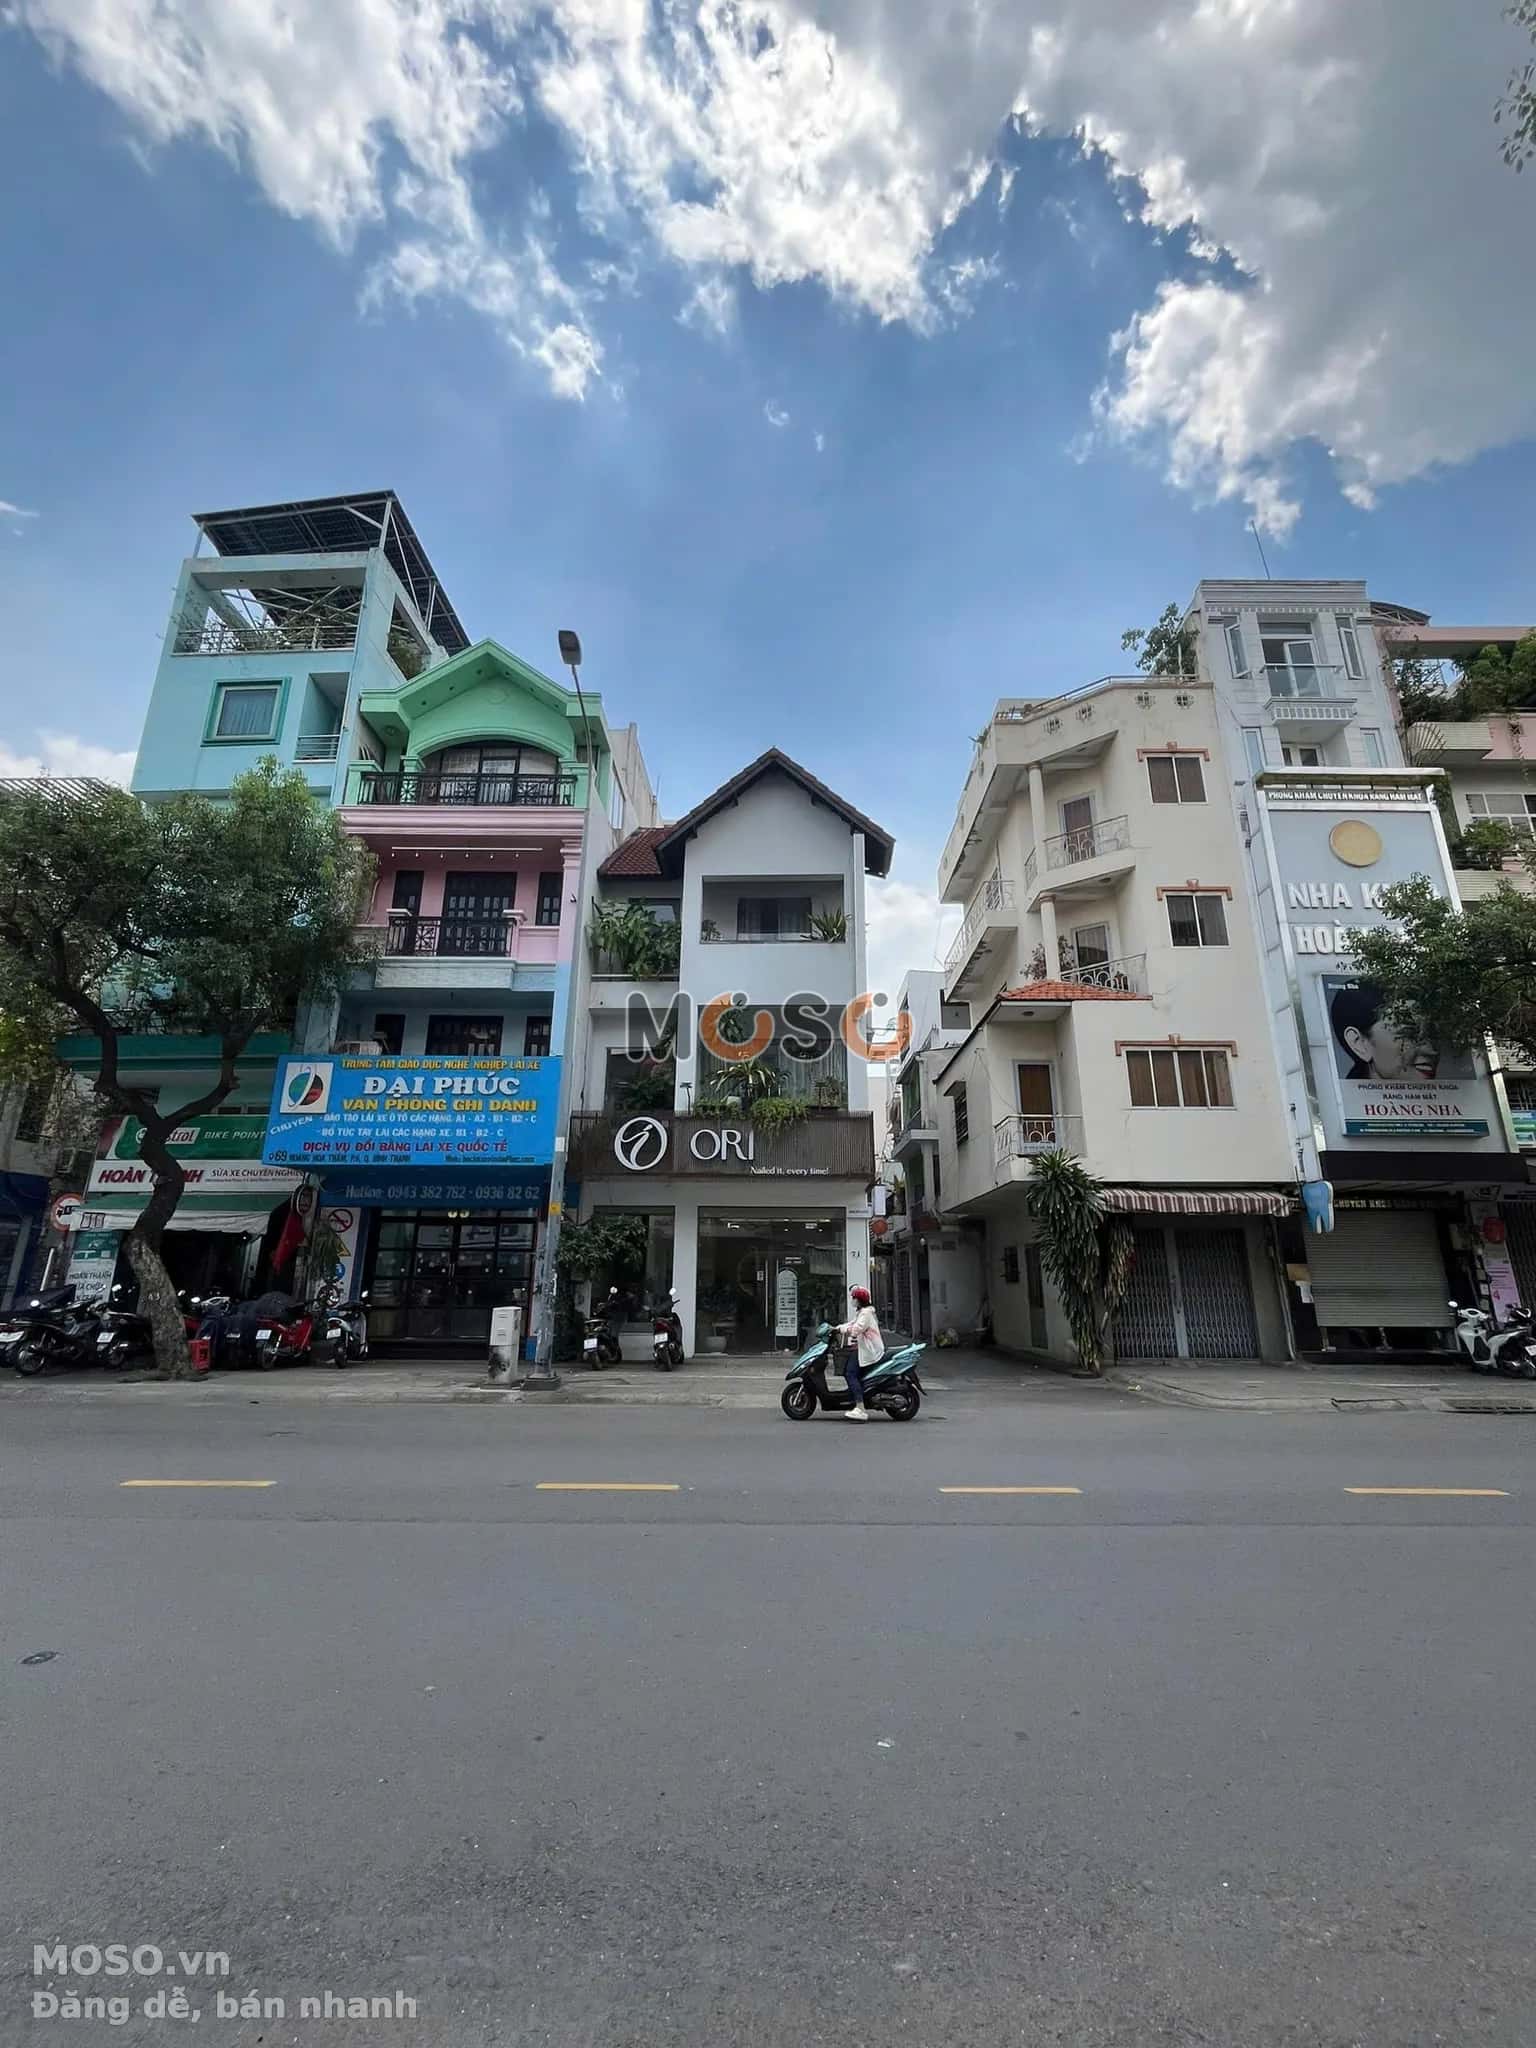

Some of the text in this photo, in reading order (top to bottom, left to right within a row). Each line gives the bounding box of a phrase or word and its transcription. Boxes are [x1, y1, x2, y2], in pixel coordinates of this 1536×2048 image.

[1287, 882, 1353, 909] NHA
[363, 1071, 521, 1098] ĐẠI PHÚC
[453, 1099, 483, 1111] GHI
[489, 1099, 537, 1112] DANH
[1364, 1101, 1464, 1116] HOÀNG NHA
[530, 1114, 537, 1124] C
[204, 1131, 229, 1140] BIKE
[232, 1131, 266, 1140] POINT
[497, 1128, 504, 1137] C
[303, 1142, 331, 1153] DỊCH
[438, 1142, 453, 1152] XE
[690, 1129, 754, 1161] ORI
[98, 1165, 146, 1183] HOÀN
[230, 1169, 241, 1177] XE
[751, 1166, 776, 1175] Nailed
[786, 1167, 808, 1176] every
[421, 1185, 442, 1200] 382
[445, 1185, 466, 1200] 782
